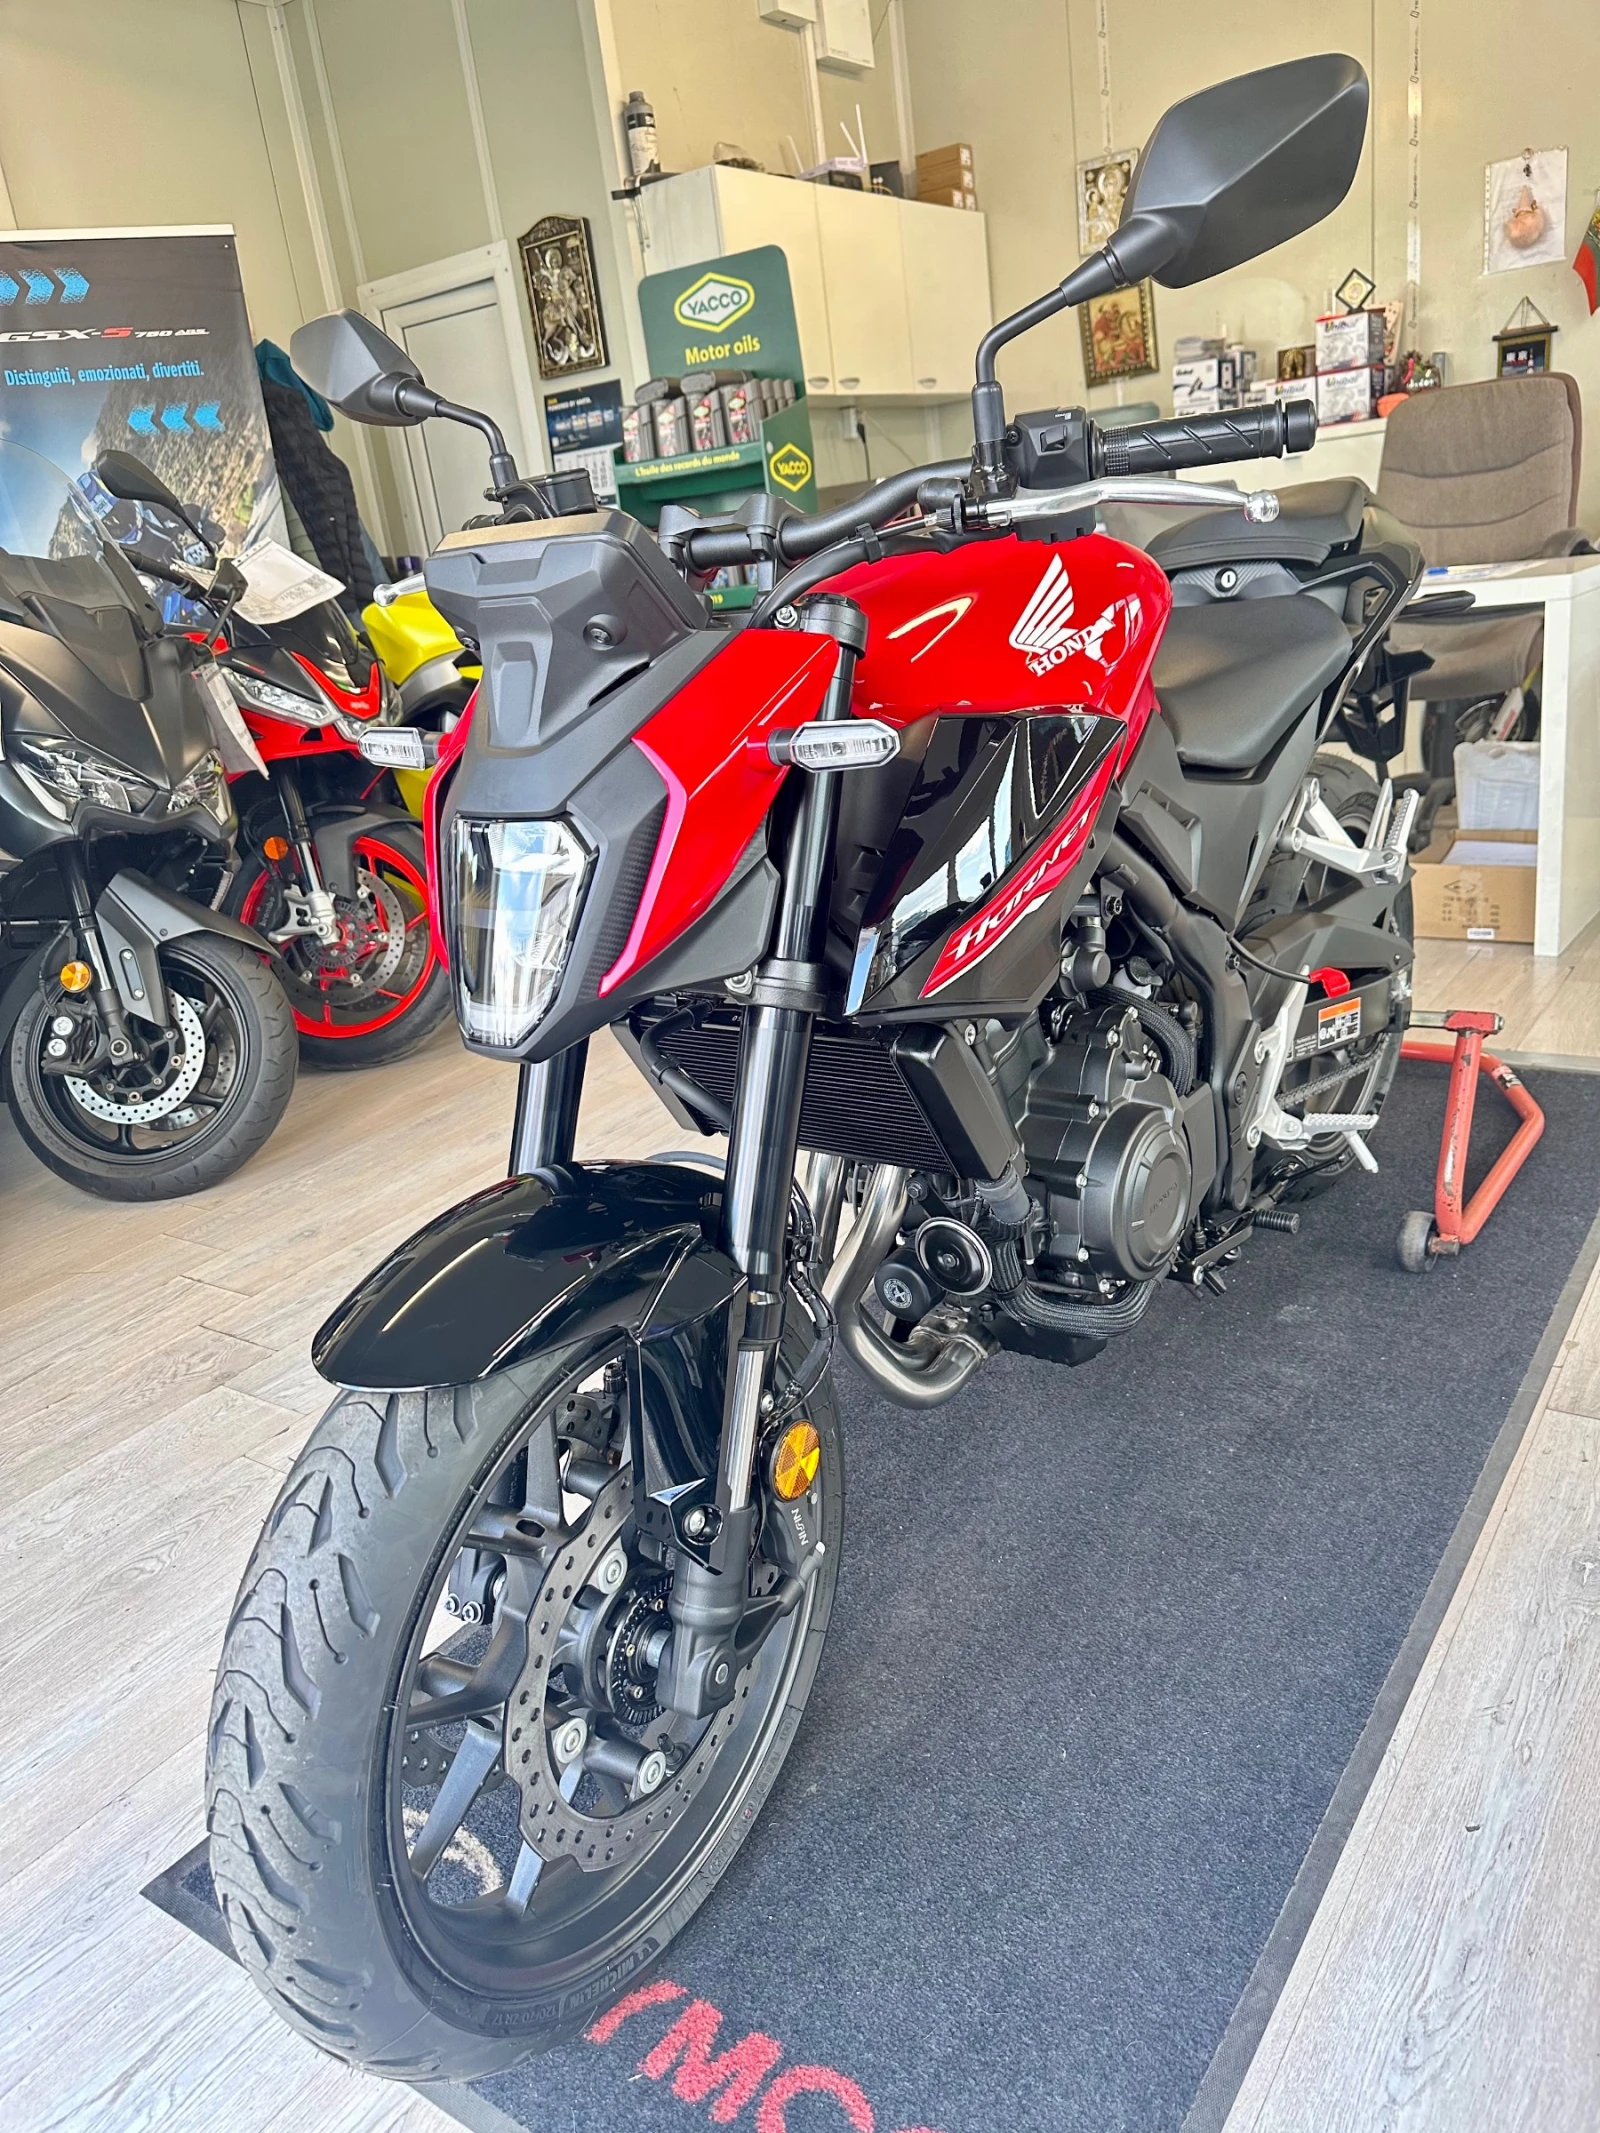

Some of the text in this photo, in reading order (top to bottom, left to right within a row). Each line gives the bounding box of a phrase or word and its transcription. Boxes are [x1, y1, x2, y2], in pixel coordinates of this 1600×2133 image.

[687, 290, 743, 316] YACCO
[0, 327, 134, 343] GSX-S
[685, 334, 761, 366] Motor oils
[3, 359, 205, 388] Distinguiti, emozionati, divertiti.
[635, 451, 741, 478] L'huile des records du monde
[776, 461, 807, 476] YACCO
[944, 795, 1099, 961] HORNET
[258, 896, 275, 927] brembo
[569, 1955, 635, 2008] MICHELIN
[521, 2005, 558, 2024] 120/70
